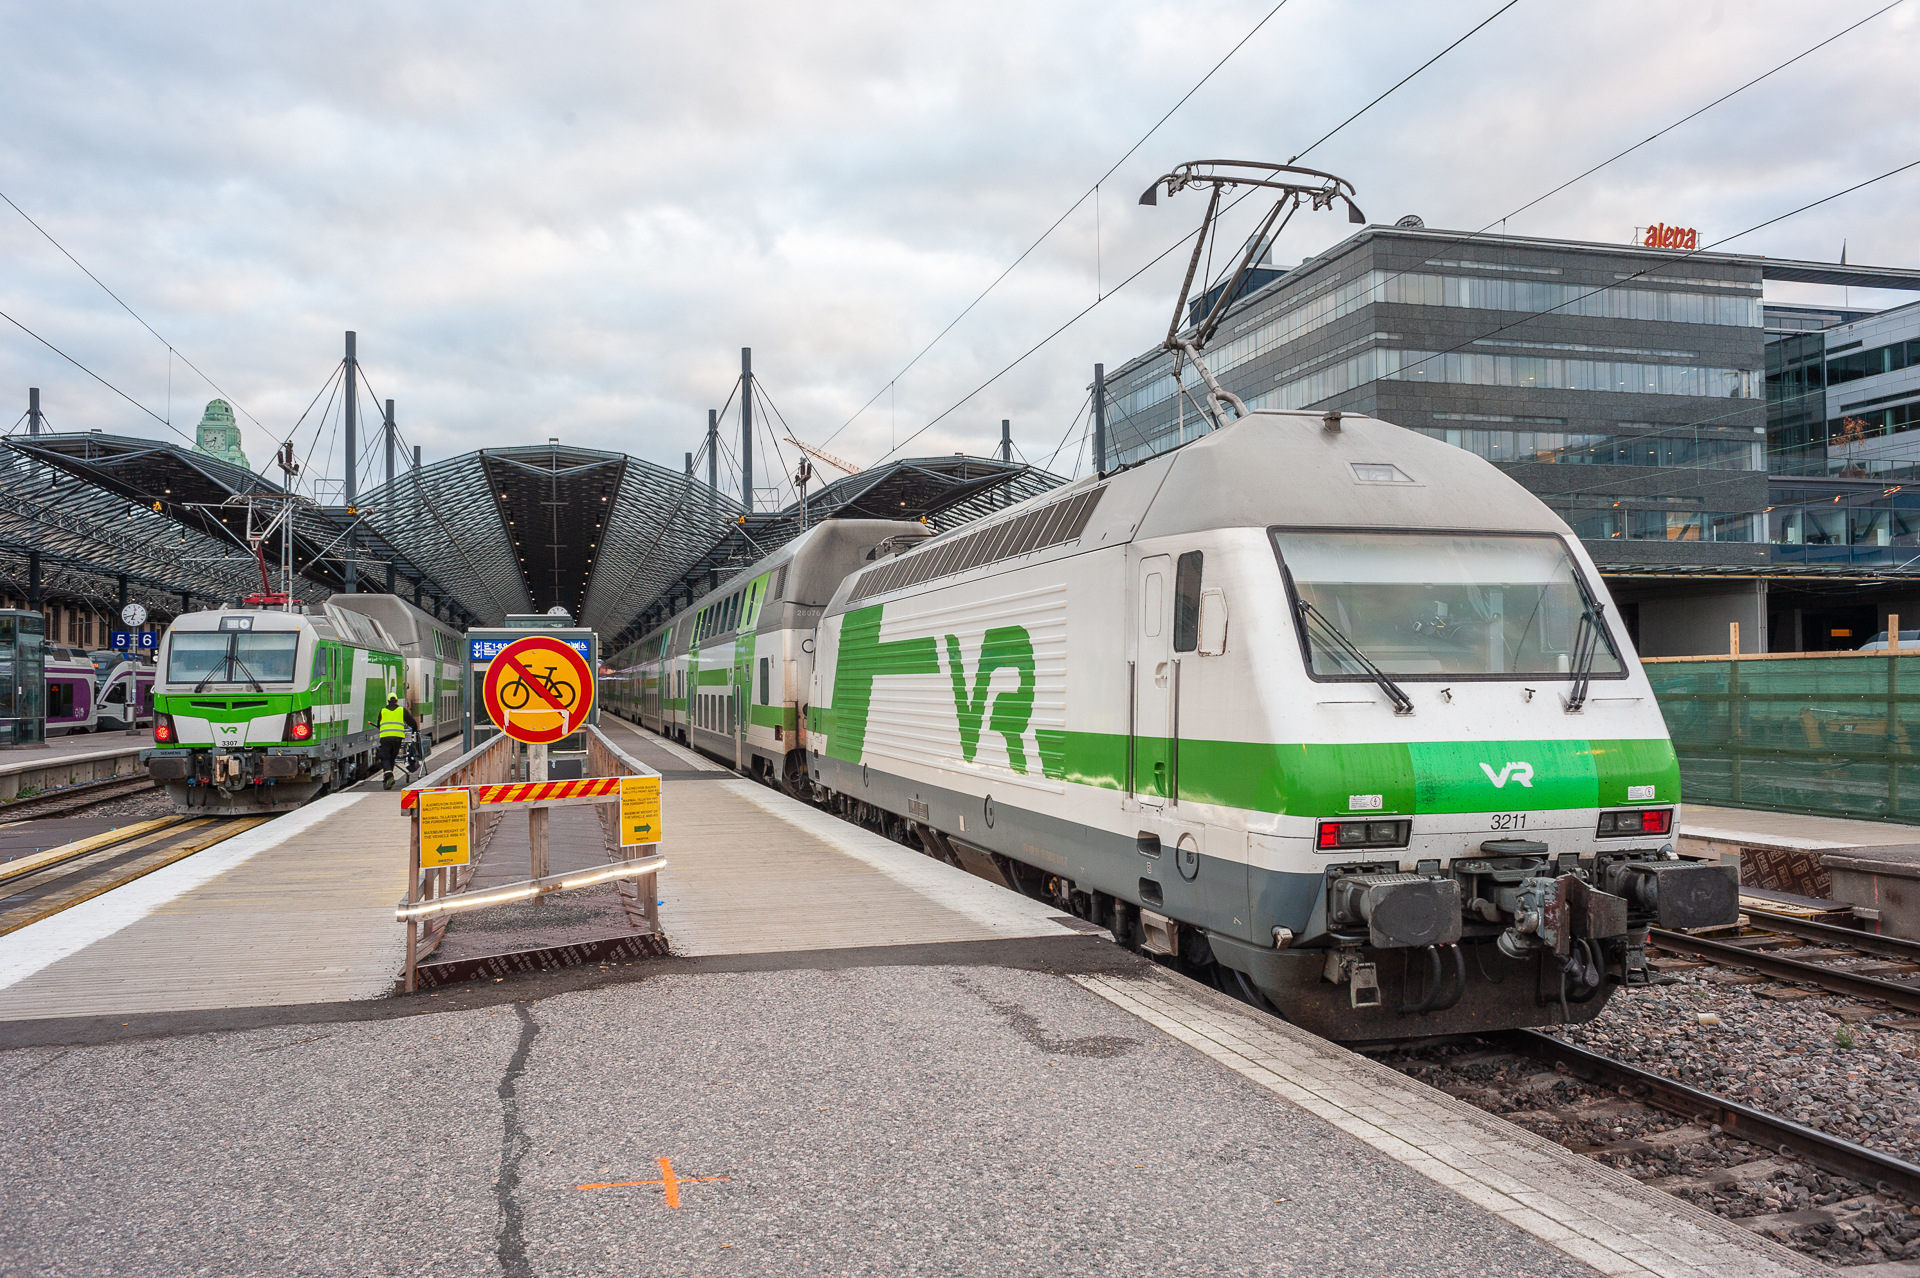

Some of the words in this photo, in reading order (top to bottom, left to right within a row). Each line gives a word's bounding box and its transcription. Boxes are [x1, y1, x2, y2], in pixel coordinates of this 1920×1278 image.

[1644, 222, 1696, 250] alepa
[116, 634, 126, 646] 5
[142, 634, 152, 646] 6
[944, 624, 1036, 776] VR
[1479, 761, 1534, 788] VR
[1490, 814, 1526, 830] 3211
